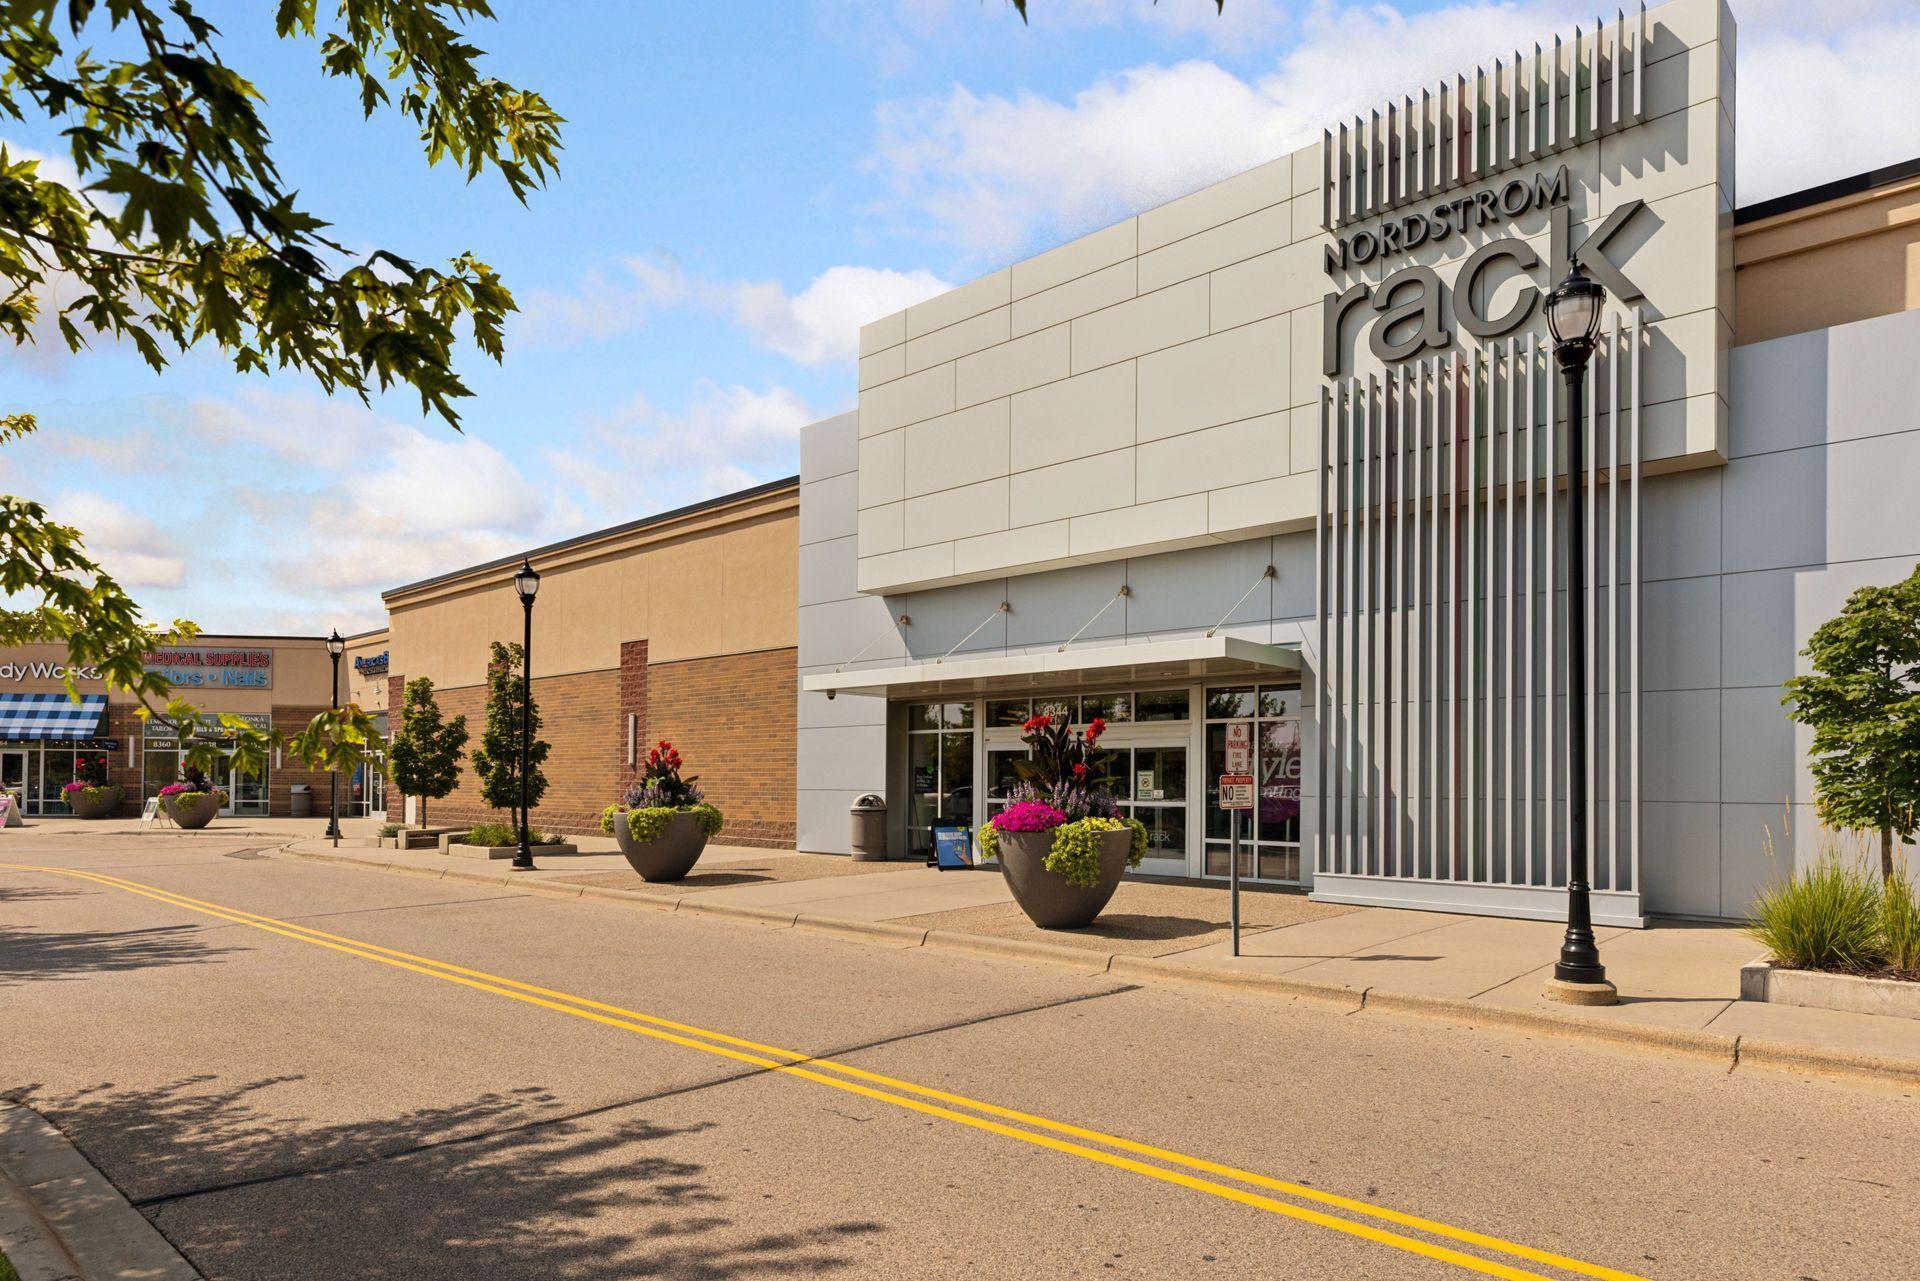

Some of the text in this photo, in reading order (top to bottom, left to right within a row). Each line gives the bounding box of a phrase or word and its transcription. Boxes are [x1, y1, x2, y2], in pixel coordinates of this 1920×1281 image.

[1323, 164, 1570, 275] NORDSTROM
[1323, 198, 1646, 378] rack
[143, 651, 270, 667] MEDICAL SUPPLIES
[30, 662, 103, 680] Woks
[222, 668, 268, 687] Nails
[1233, 728, 1242, 738] NO
[1227, 740, 1249, 750] PARKING
[1232, 751, 1242, 759] FIRE
[1222, 786, 1234, 801] NO
[1149, 831, 1171, 842] rack
